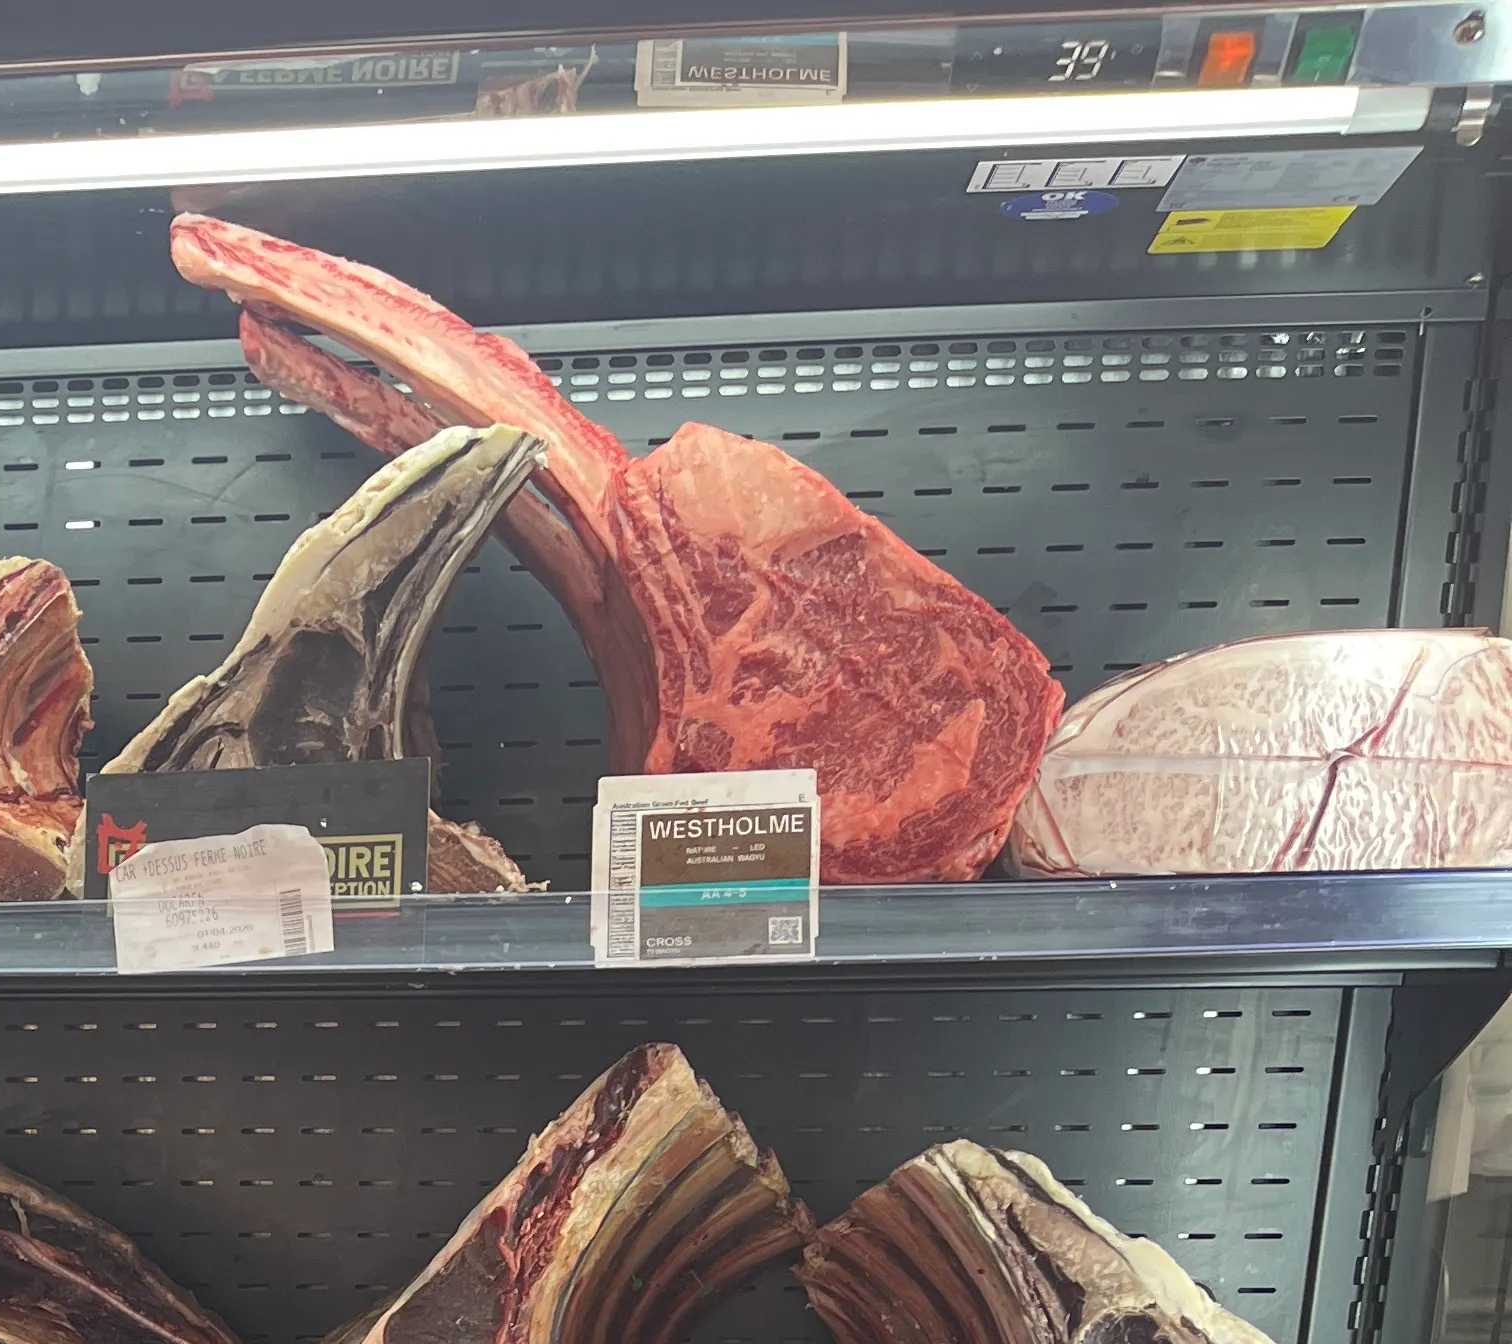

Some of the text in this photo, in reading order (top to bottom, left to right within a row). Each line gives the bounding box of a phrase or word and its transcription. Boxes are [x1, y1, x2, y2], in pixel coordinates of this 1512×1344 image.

[649, 813, 805, 840] WESTHOLME
[115, 862, 136, 882] CAR
[194, 847, 228, 867] FERME
[233, 838, 268, 860] NOIRE
[701, 889, 720, 900] AA
[646, 936, 693, 948] CROSS
